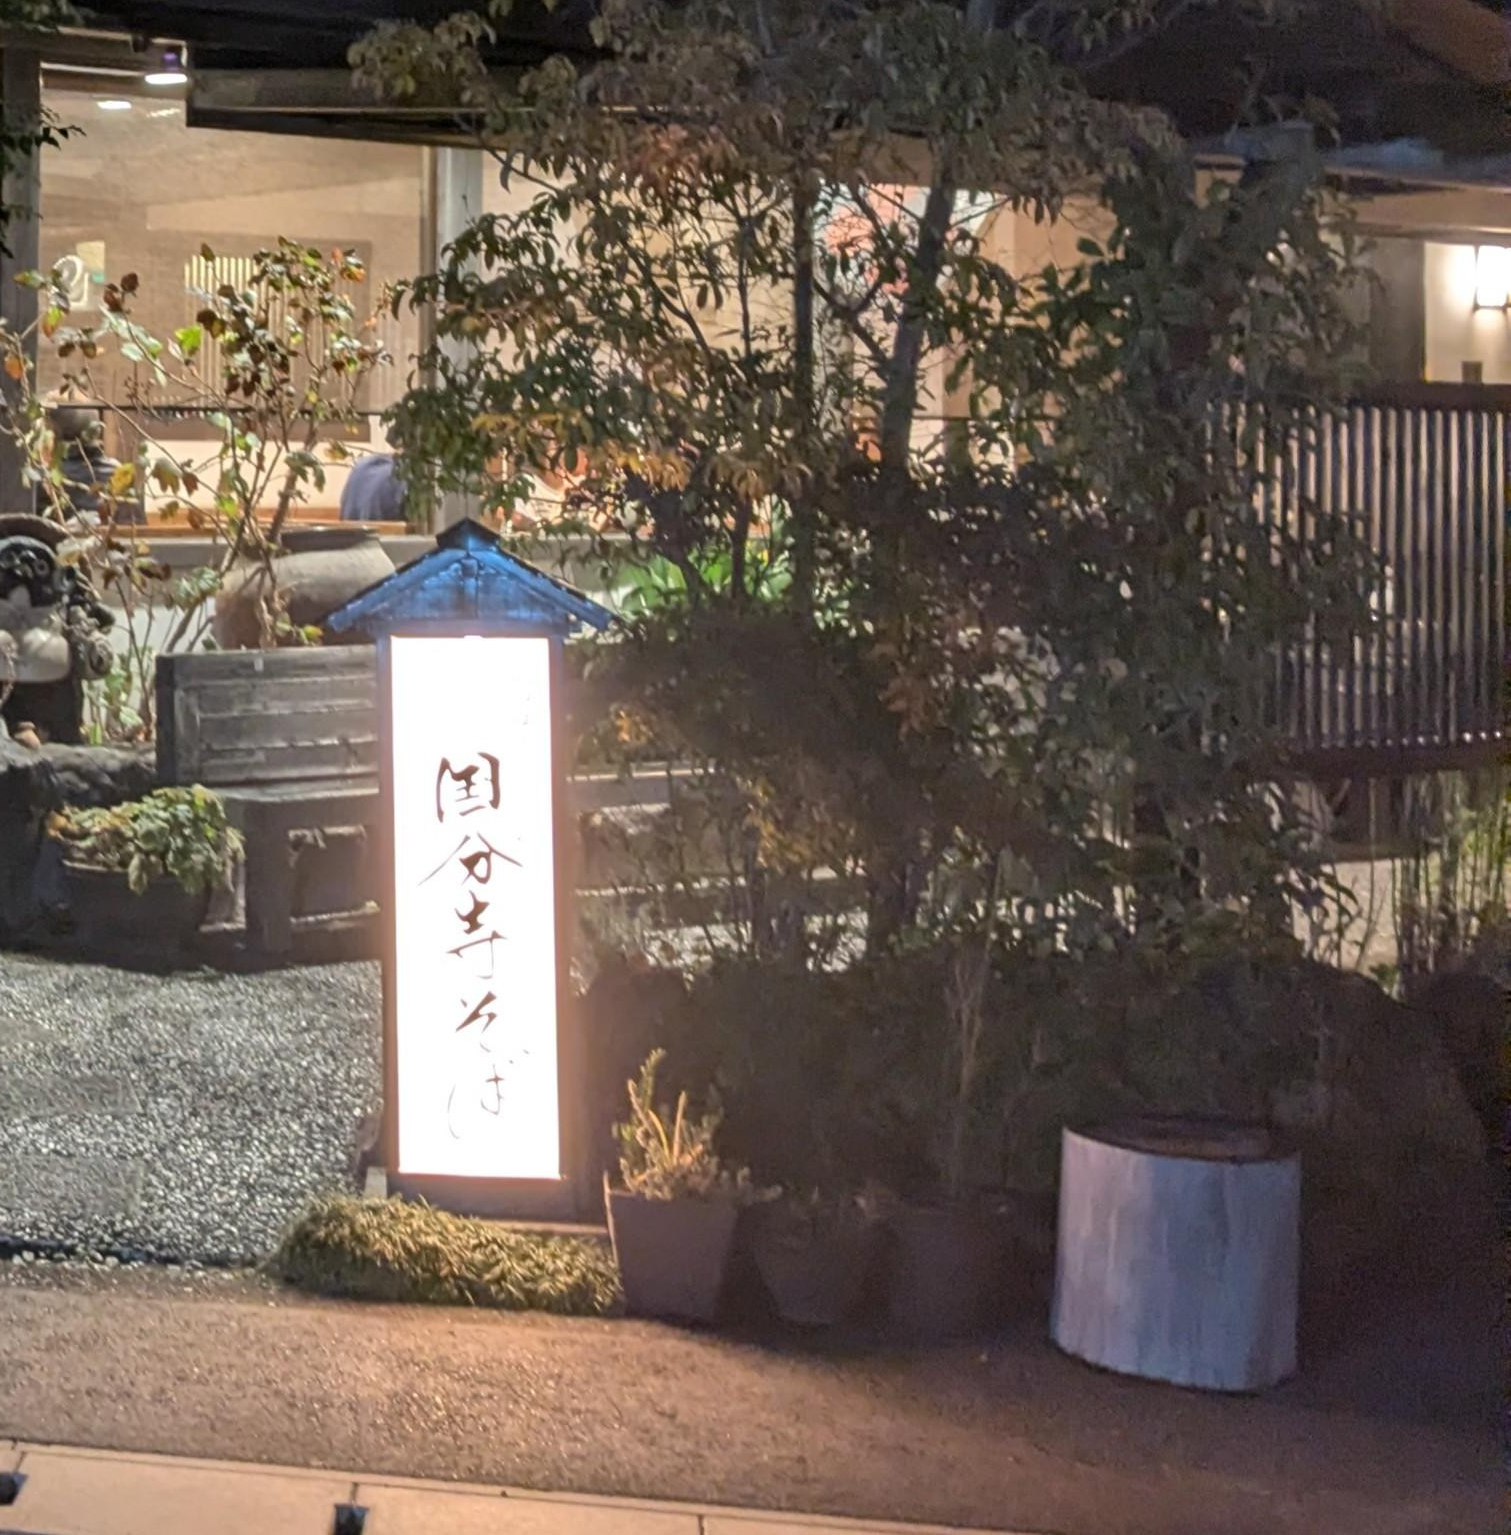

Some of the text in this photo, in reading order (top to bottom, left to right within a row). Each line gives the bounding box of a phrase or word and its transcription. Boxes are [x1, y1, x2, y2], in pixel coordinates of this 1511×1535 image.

[417, 752, 531, 1139] 国分寺そば
